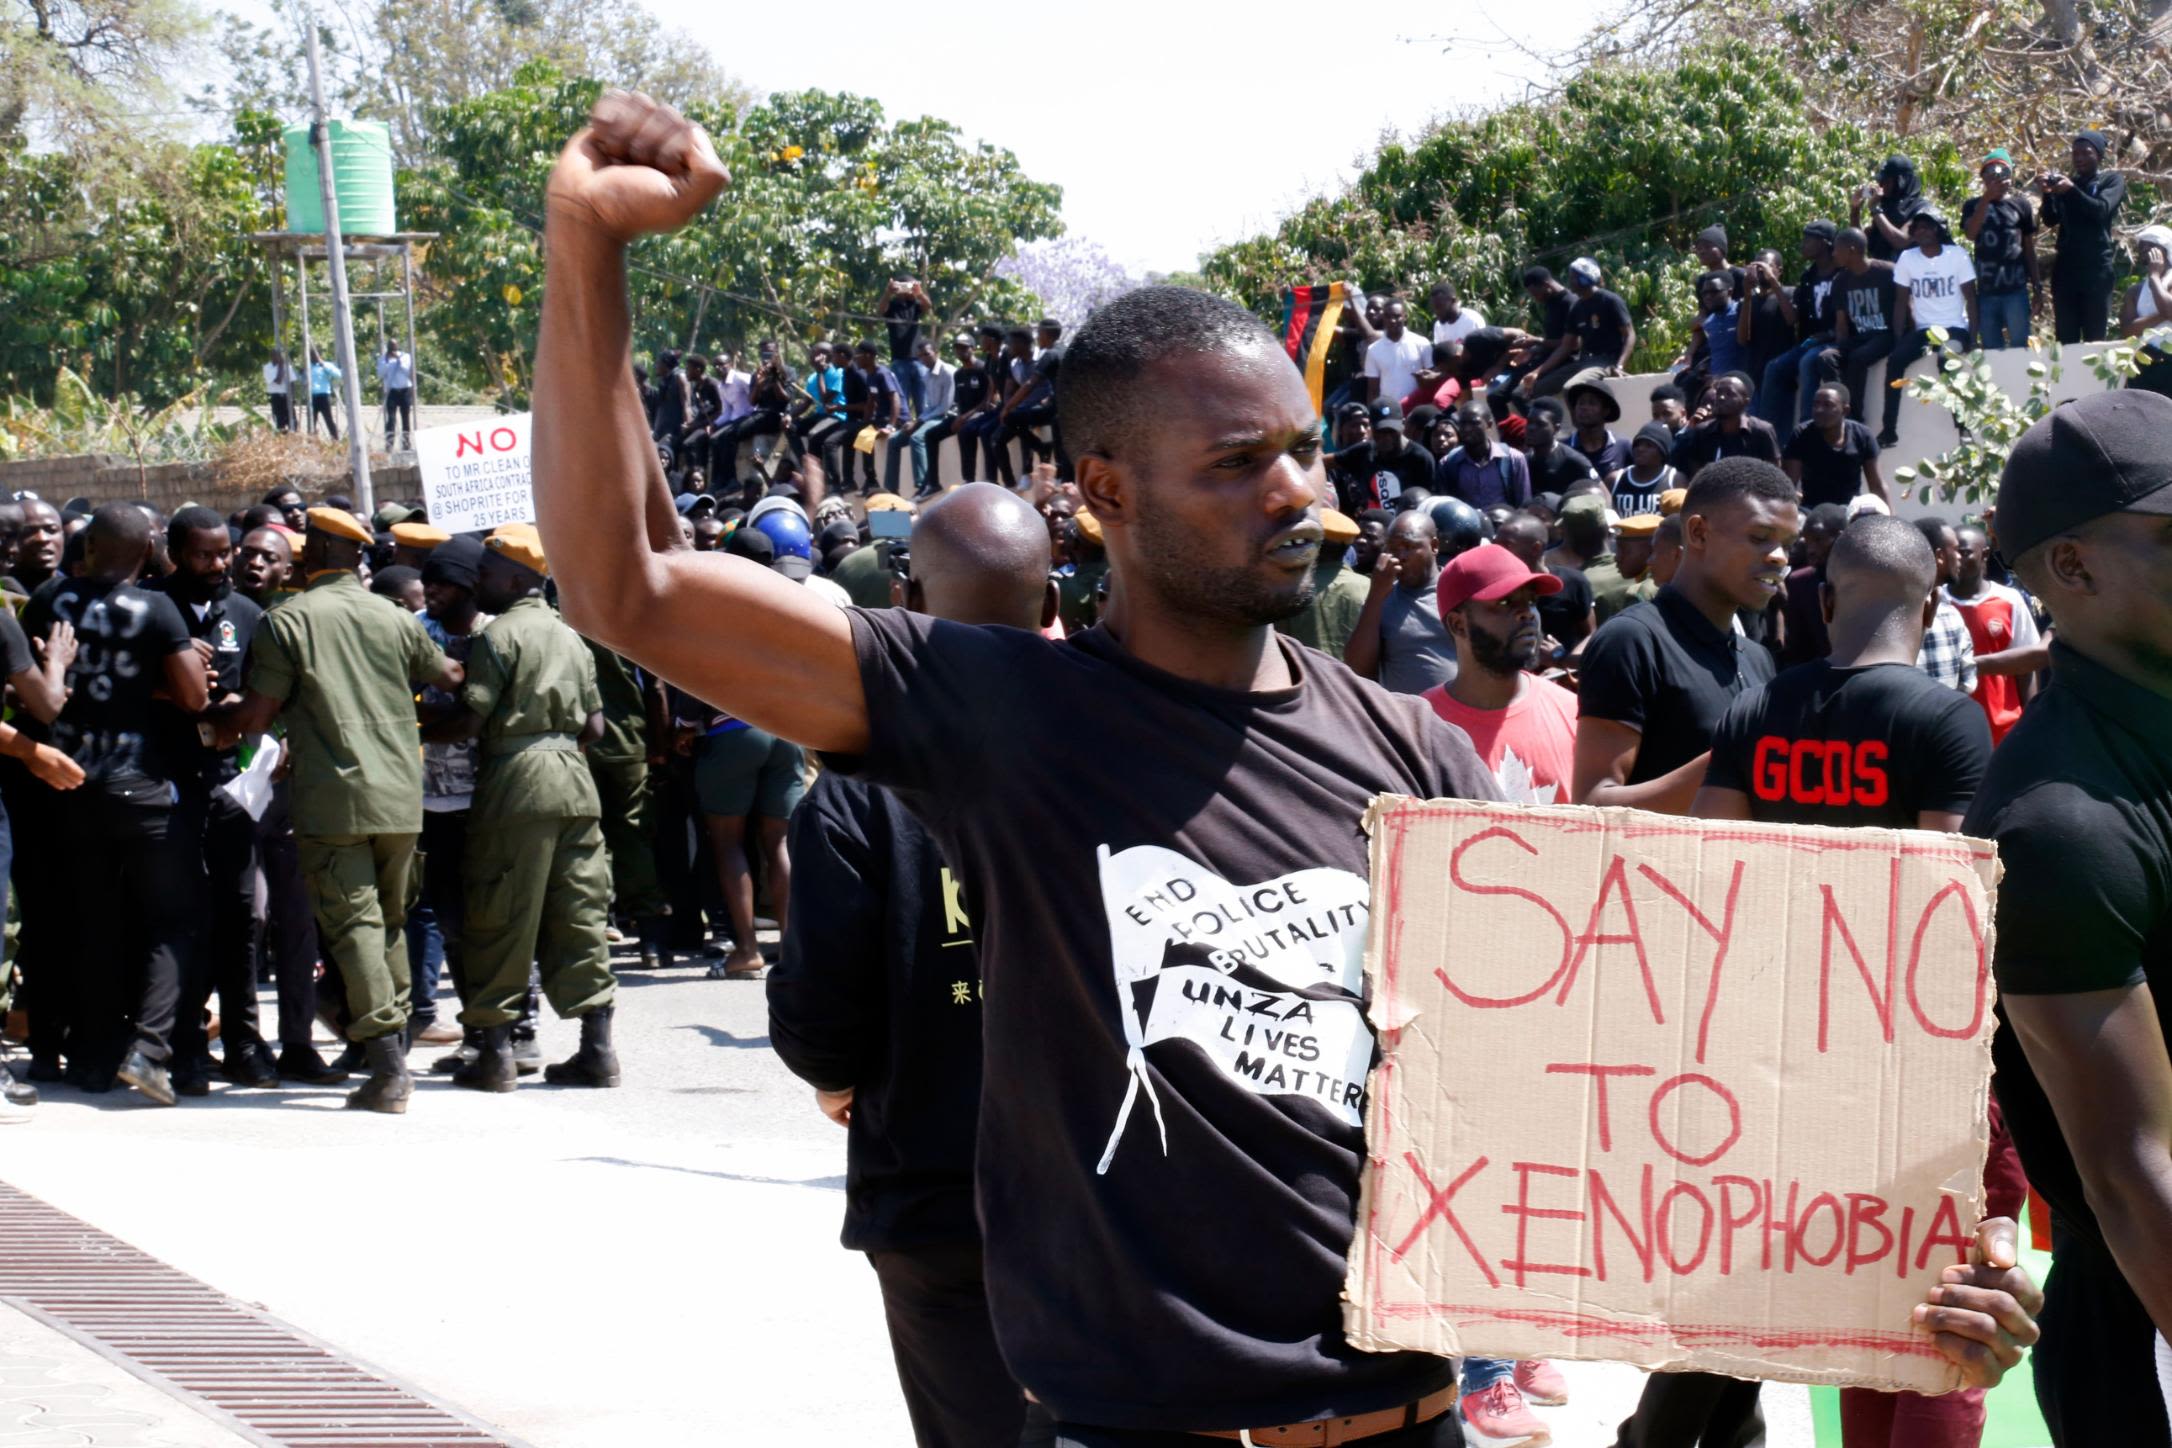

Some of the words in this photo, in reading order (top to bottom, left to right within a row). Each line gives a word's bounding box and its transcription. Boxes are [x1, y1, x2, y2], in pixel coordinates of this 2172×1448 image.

[456, 427, 517, 458] NO
[435, 482, 463, 499] SOUTH
[465, 478, 493, 493] AFRICA
[445, 465, 461, 479] TO
[464, 462, 480, 477] MR
[483, 458, 520, 474] CLEAN
[445, 493, 503, 514] SHOPRITE
[505, 490, 527, 505] FOR
[473, 513, 486, 527] 25
[488, 507, 526, 524] YEARS
[1616, 494, 1634, 512] TO
[1126, 878, 1196, 926] END
[1435, 826, 1745, 1063] SAY
[1818, 858, 1986, 1052] NO
[1182, 977, 1314, 1024] UNZA
[1220, 1015, 1320, 1061] LIVES
[1234, 1050, 1363, 1109] MATTER
[1545, 1063, 1741, 1165] TO
[1390, 1153, 1976, 1289] XENOPHOBIA
